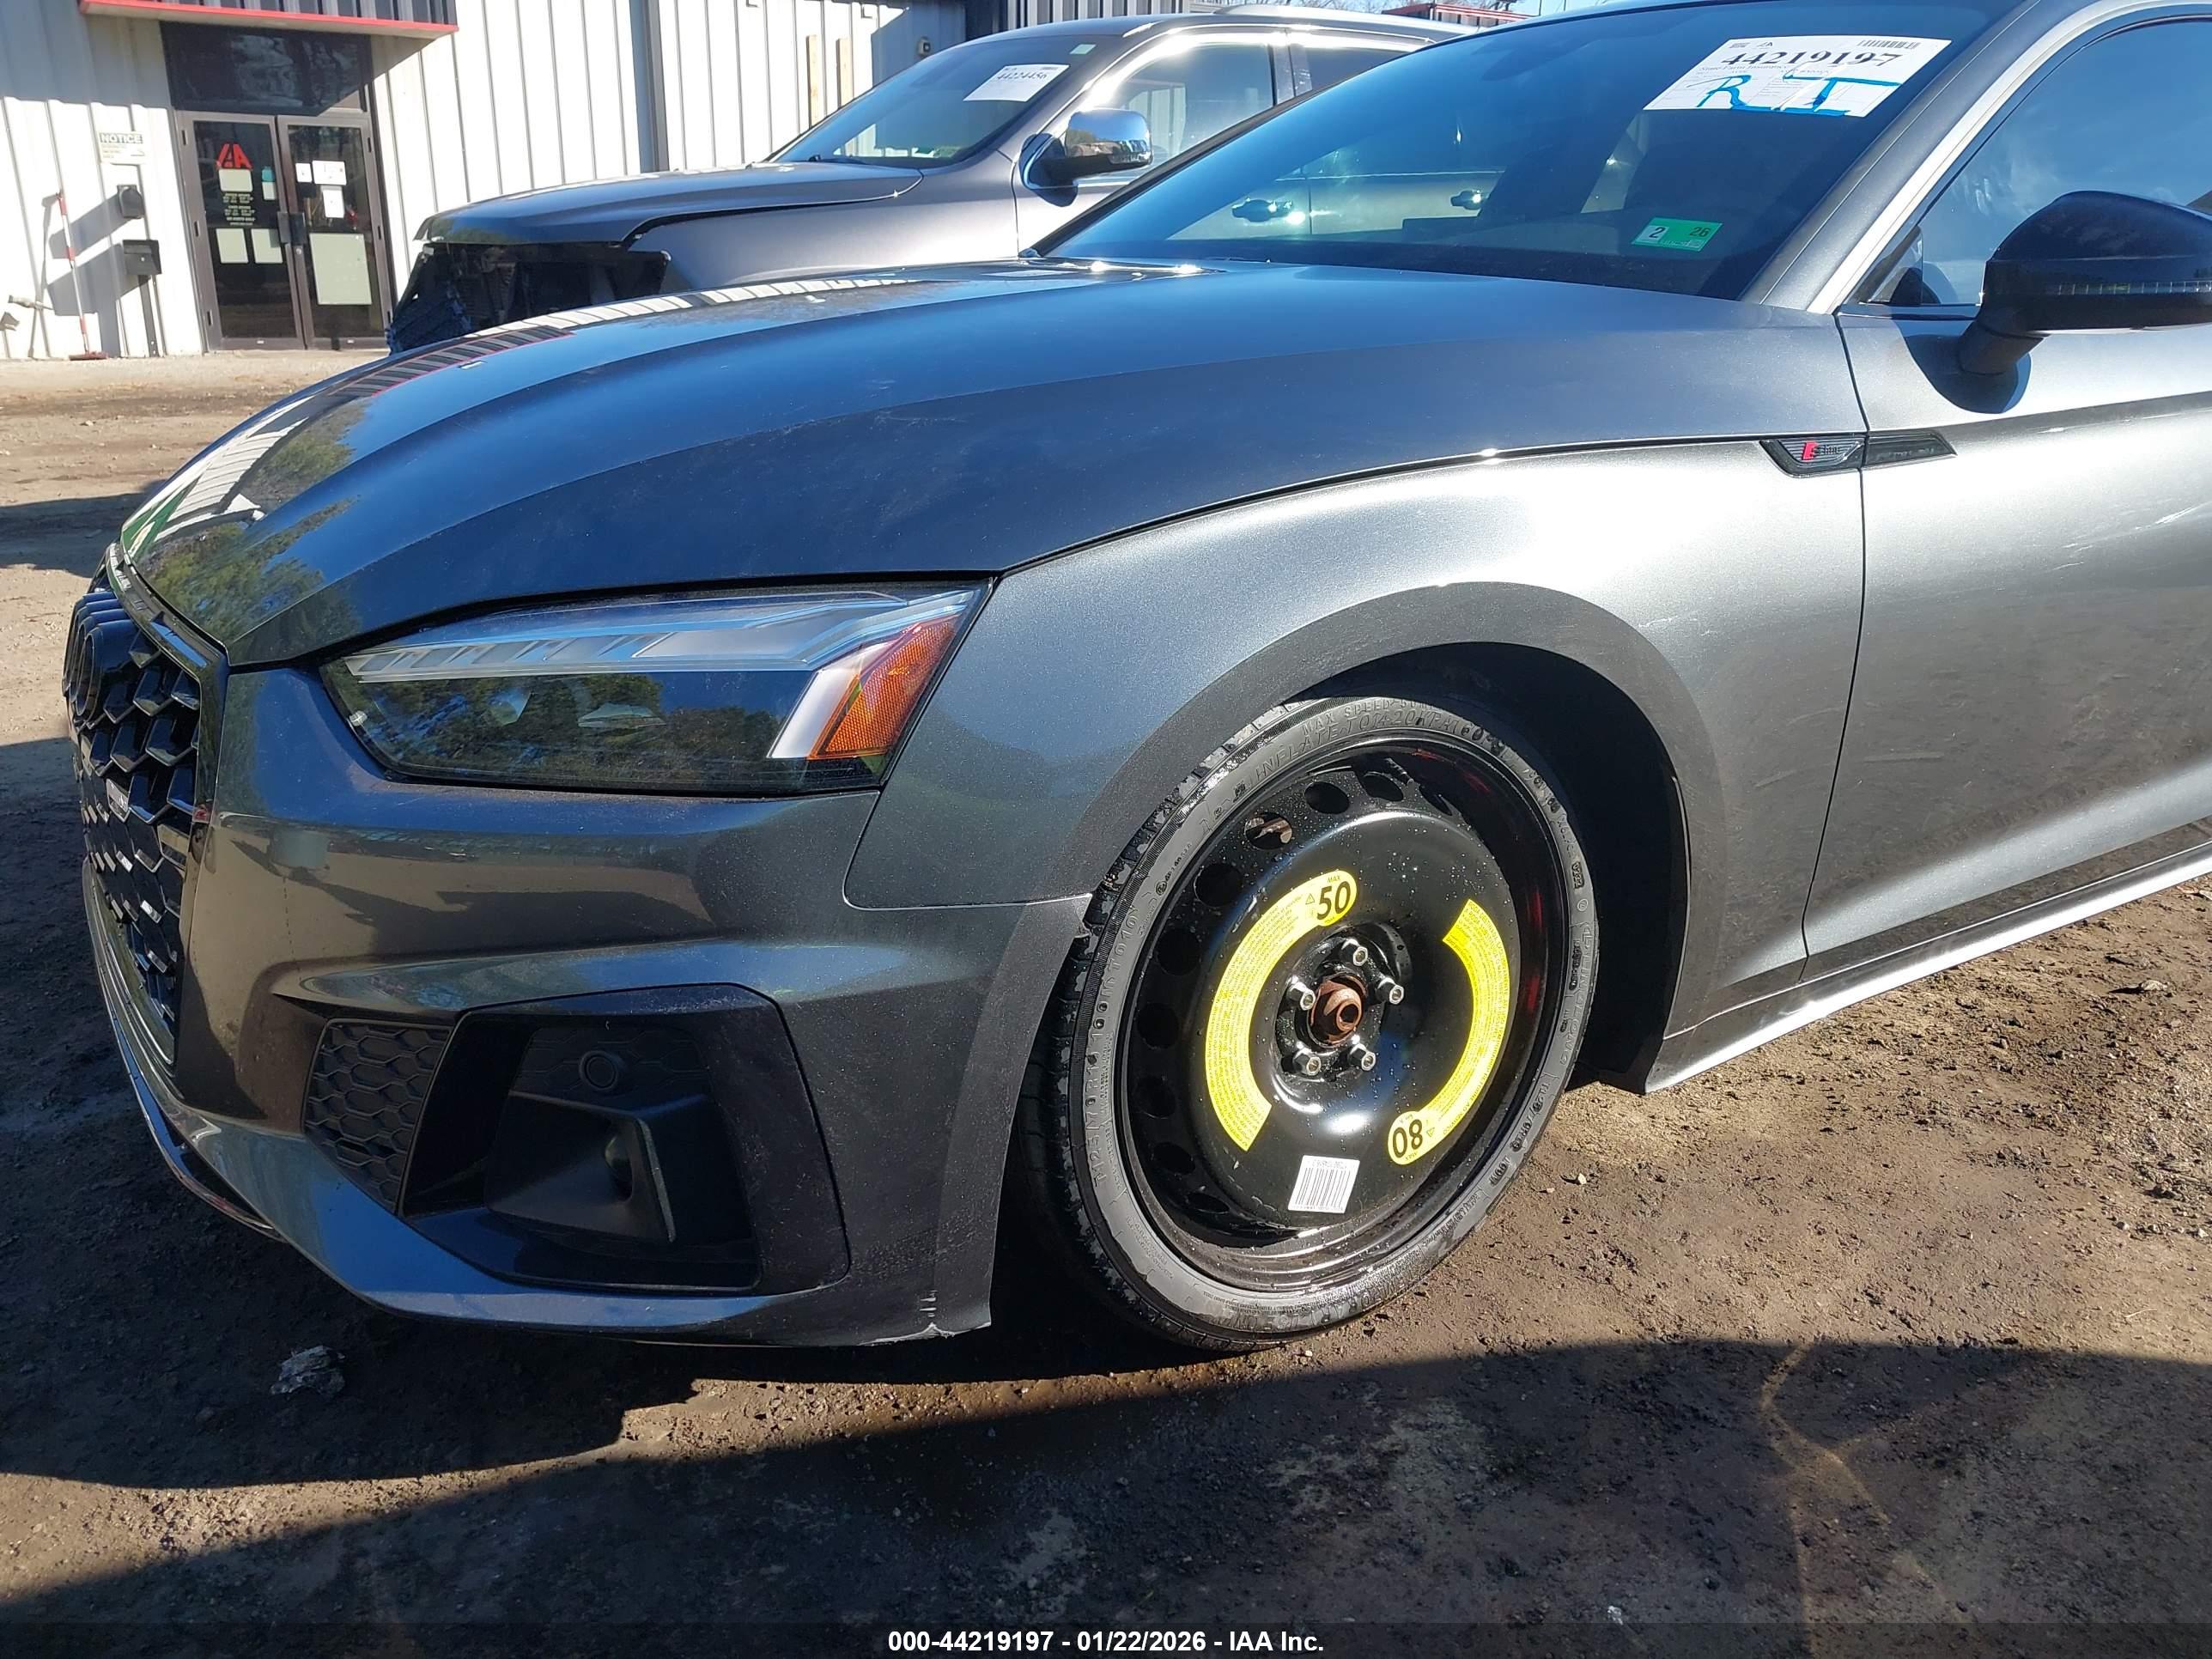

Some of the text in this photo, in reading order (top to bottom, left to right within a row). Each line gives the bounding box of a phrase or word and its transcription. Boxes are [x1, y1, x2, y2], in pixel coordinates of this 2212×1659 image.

[1721, 50, 1904, 67] 44219197
[100, 133, 143, 144] NOTICE
[1649, 226, 1711, 239] 2 26
[1317, 880, 1351, 921] 50
[1392, 1119, 1423, 1158] 80
